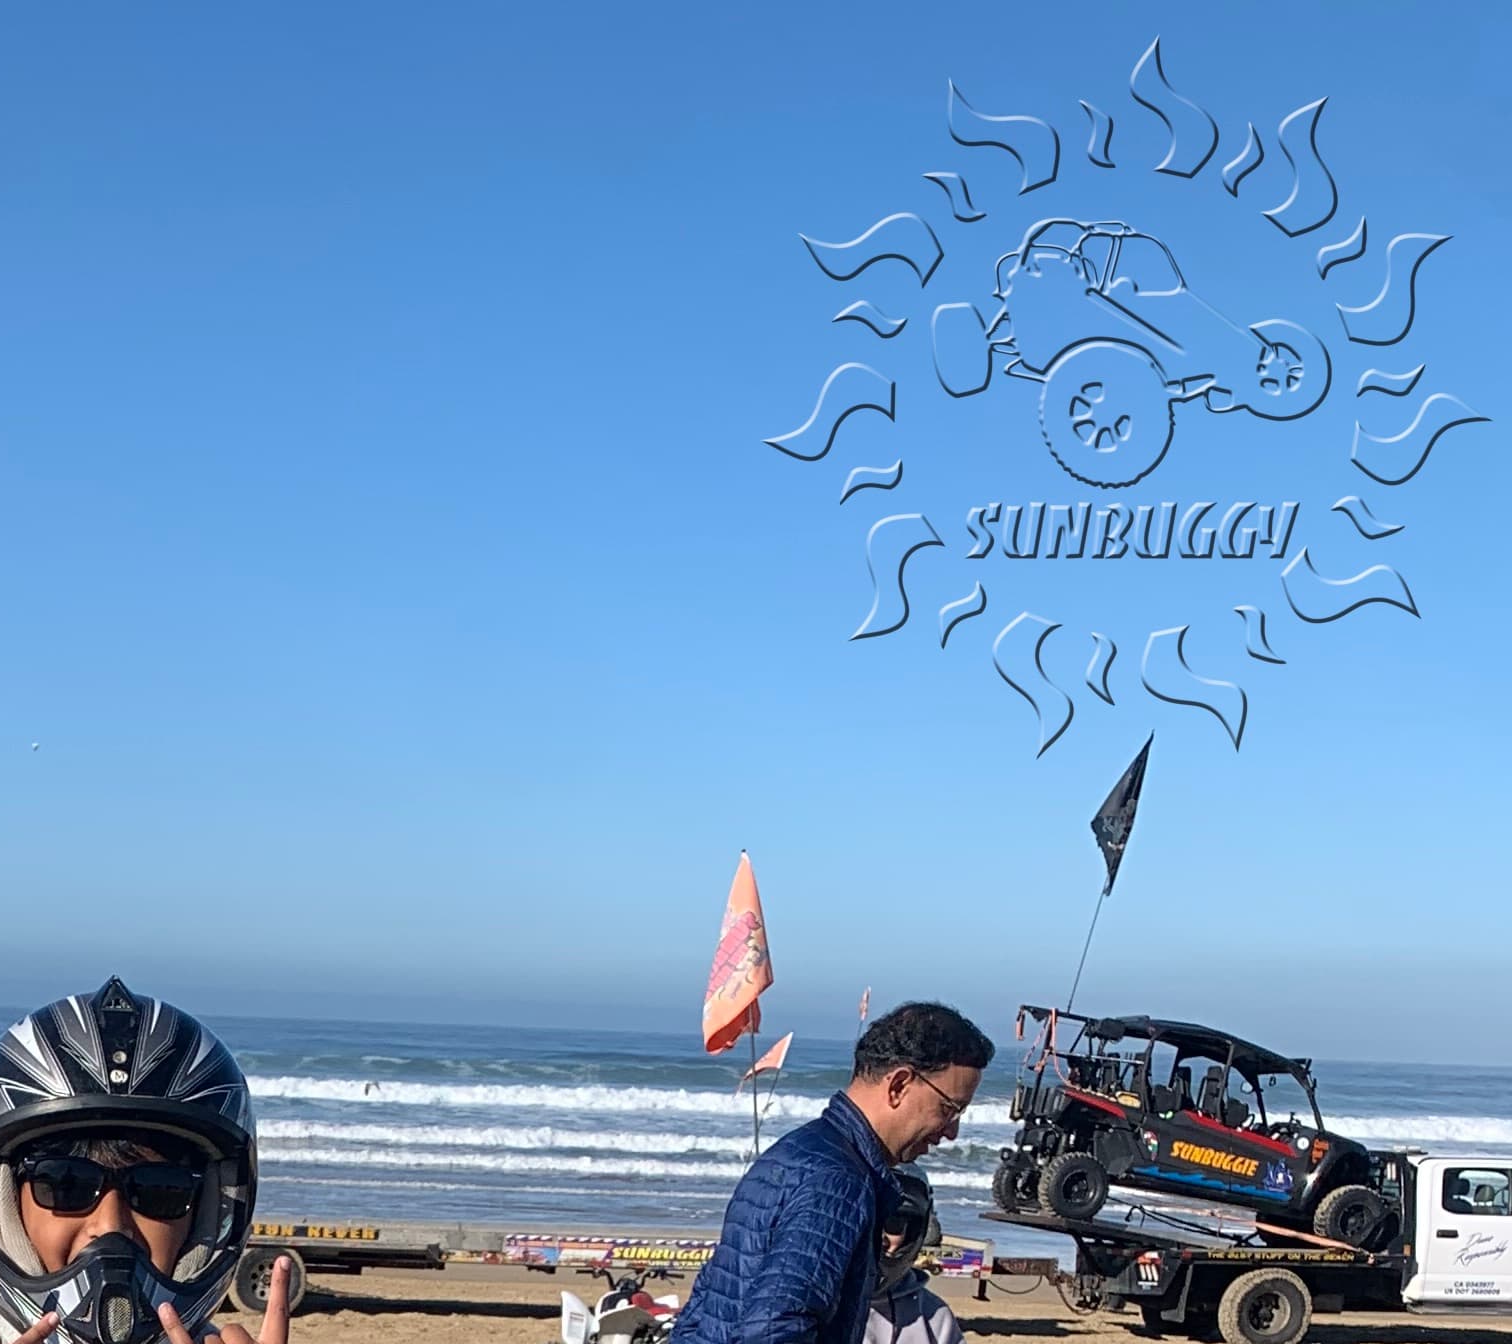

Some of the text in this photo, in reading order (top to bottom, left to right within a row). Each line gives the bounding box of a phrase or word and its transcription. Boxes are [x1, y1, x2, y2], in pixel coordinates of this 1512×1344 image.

[1169, 1140, 1260, 1177] SUNBUGGIE
[253, 1223, 377, 1240] FUN NEVER
